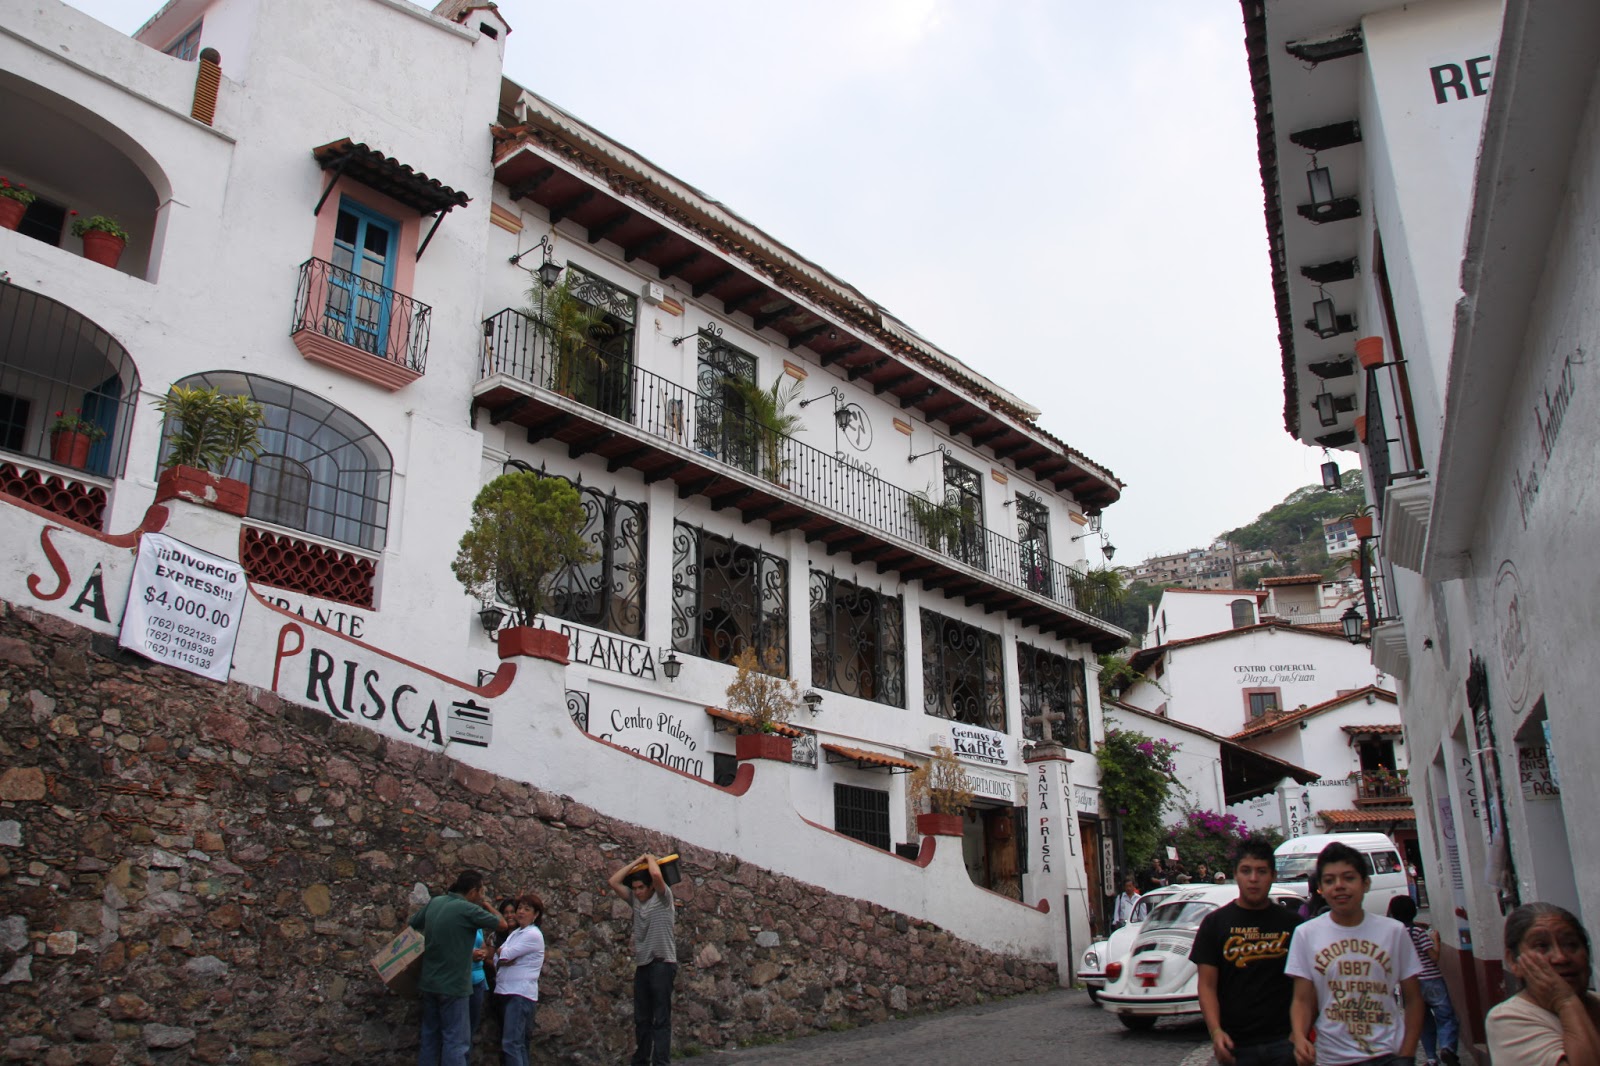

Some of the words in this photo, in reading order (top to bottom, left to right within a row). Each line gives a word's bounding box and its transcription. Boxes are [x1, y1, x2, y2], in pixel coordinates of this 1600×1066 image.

[155, 565, 232, 601] EXPRESS!!!
[144, 585, 230, 628] $4,000.00
[145, 627, 172, 644] (762)
[174, 637, 215, 657] 1019398
[148, 615, 175, 632] (762)
[177, 624, 217, 645] 6221238
[144, 639, 169, 657] (762)
[171, 649, 211, 670] 1115133
[1233, 665, 1266, 673] CENTRO
[1269, 664, 1316, 672] COMERCIAL
[272, 621, 443, 745] PRISCA
[1237, 673, 1268, 687] Plaza
[610, 706, 653, 732] Centro
[656, 712, 697, 752] Platero
[952, 727, 990, 741] Genuss
[646, 742, 703, 778] Blanca
[953, 738, 1005, 759] Kaffee
[1038, 764, 1048, 810] SANTA
[1060, 763, 1076, 856] HOTEL
[1040, 817, 1050, 873] PRISCA
[1223, 931, 1290, 966] Good
[1338, 961, 1371, 977] 1987
[1348, 1022, 1373, 1036] USA
